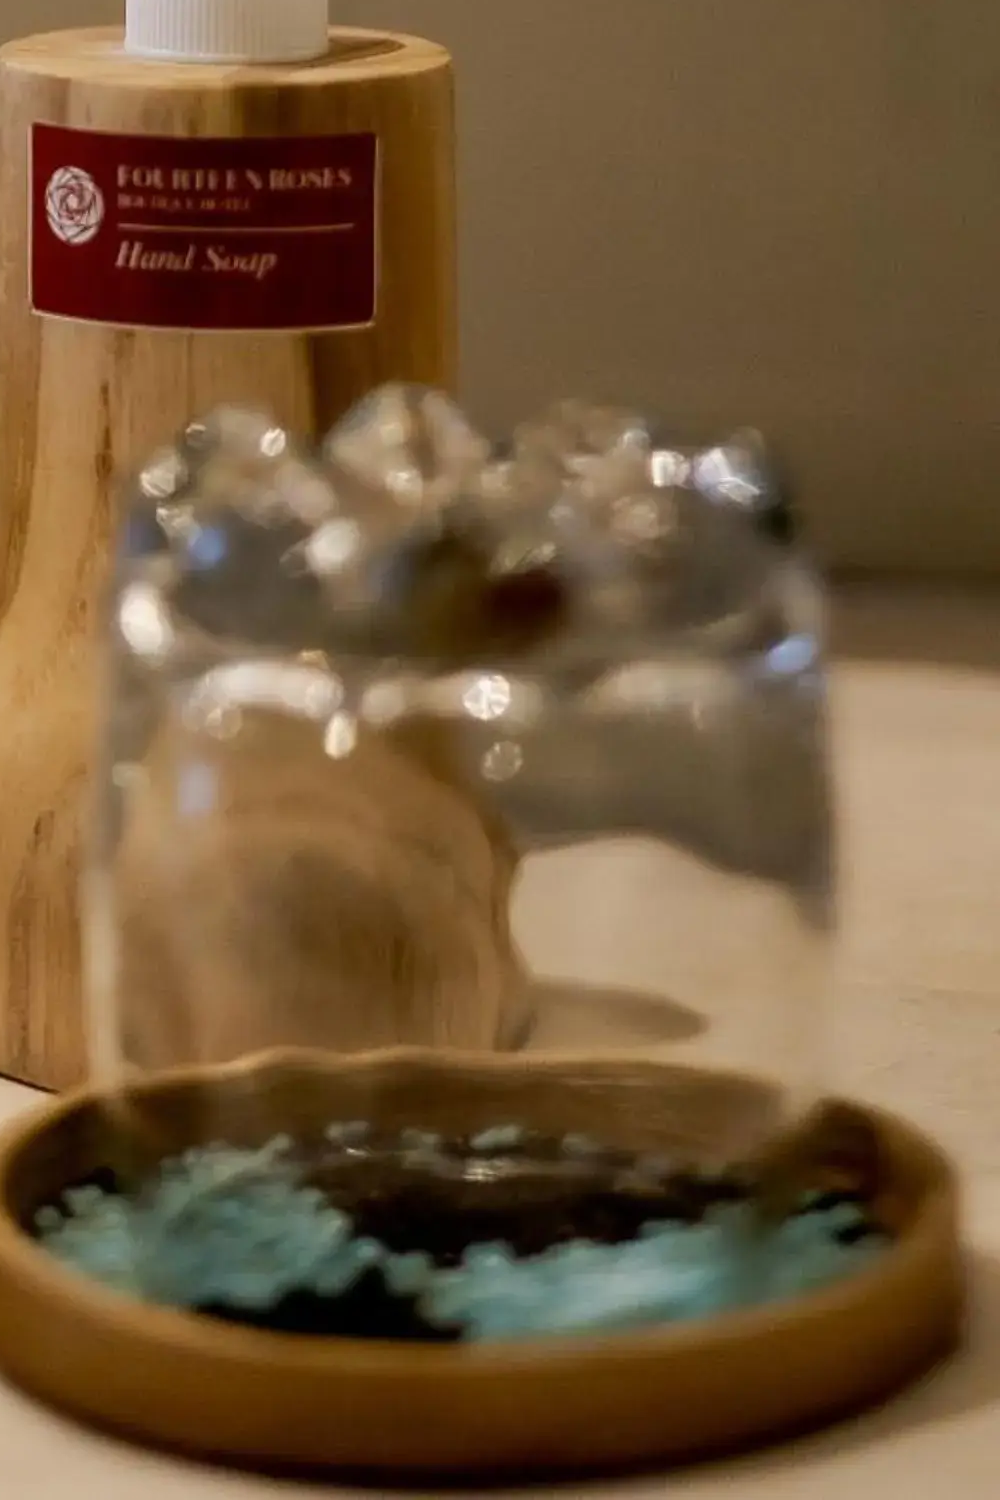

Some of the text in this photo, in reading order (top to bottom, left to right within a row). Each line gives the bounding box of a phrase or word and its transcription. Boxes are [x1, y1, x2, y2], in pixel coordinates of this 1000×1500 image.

[116, 164, 353, 191] FOURTEEN ROSES
[114, 240, 279, 280] Hand Soap
